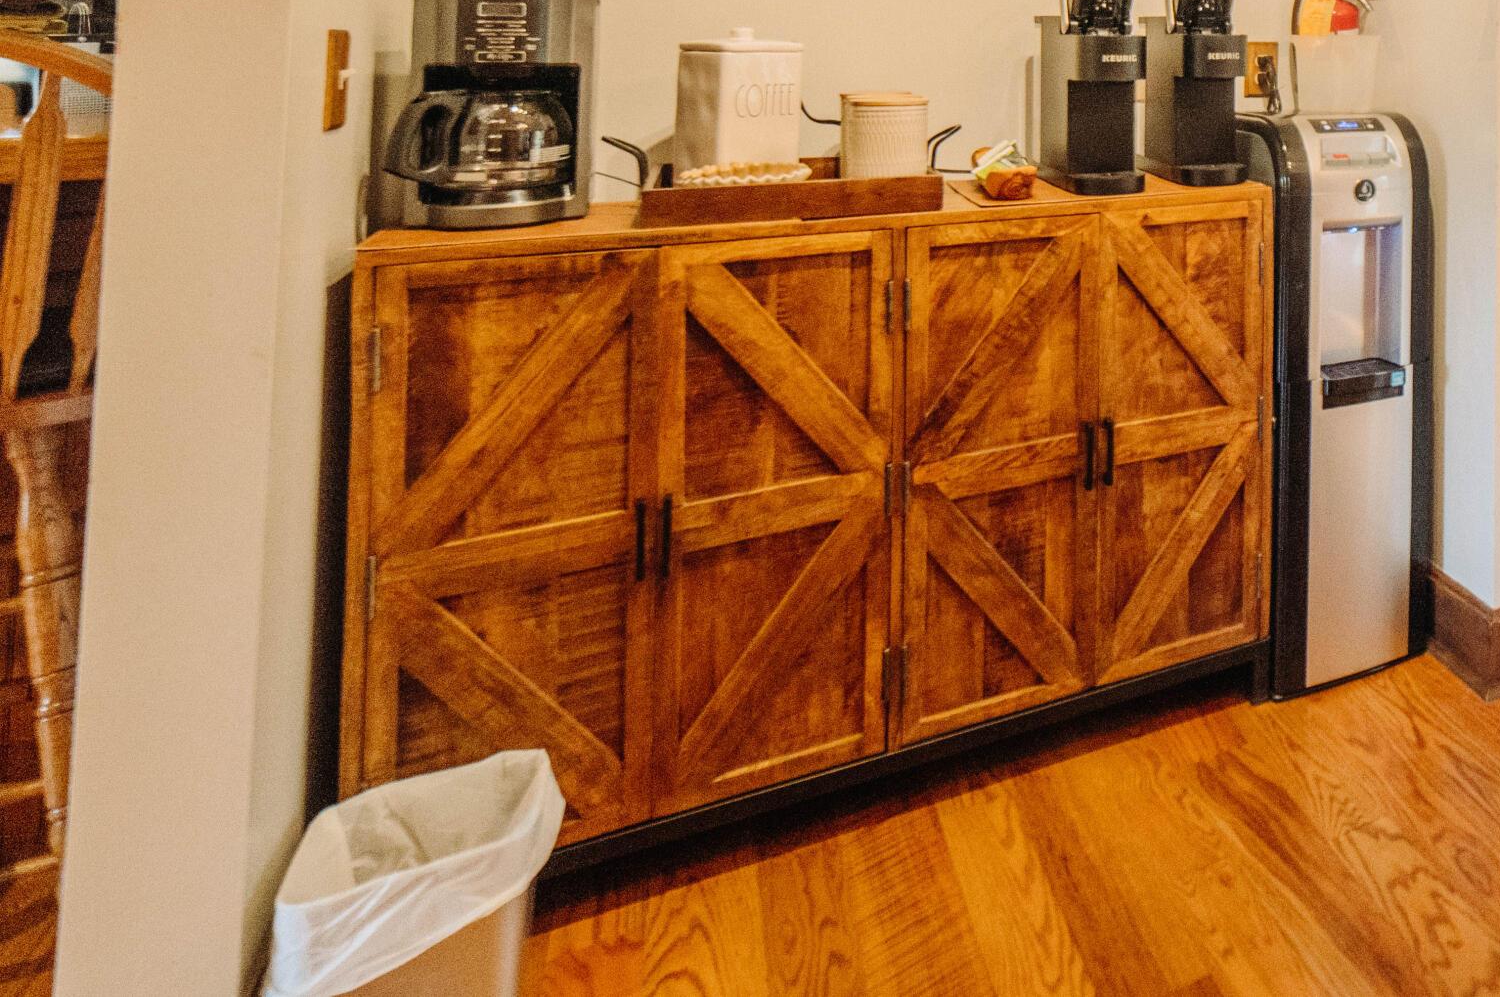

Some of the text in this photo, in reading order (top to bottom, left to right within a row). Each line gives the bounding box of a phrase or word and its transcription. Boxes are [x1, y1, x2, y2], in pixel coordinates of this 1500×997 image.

[1101, 53, 1138, 63] KEURIG
[1207, 52, 1240, 60] KEURIG
[735, 83, 796, 118] COFFEE
